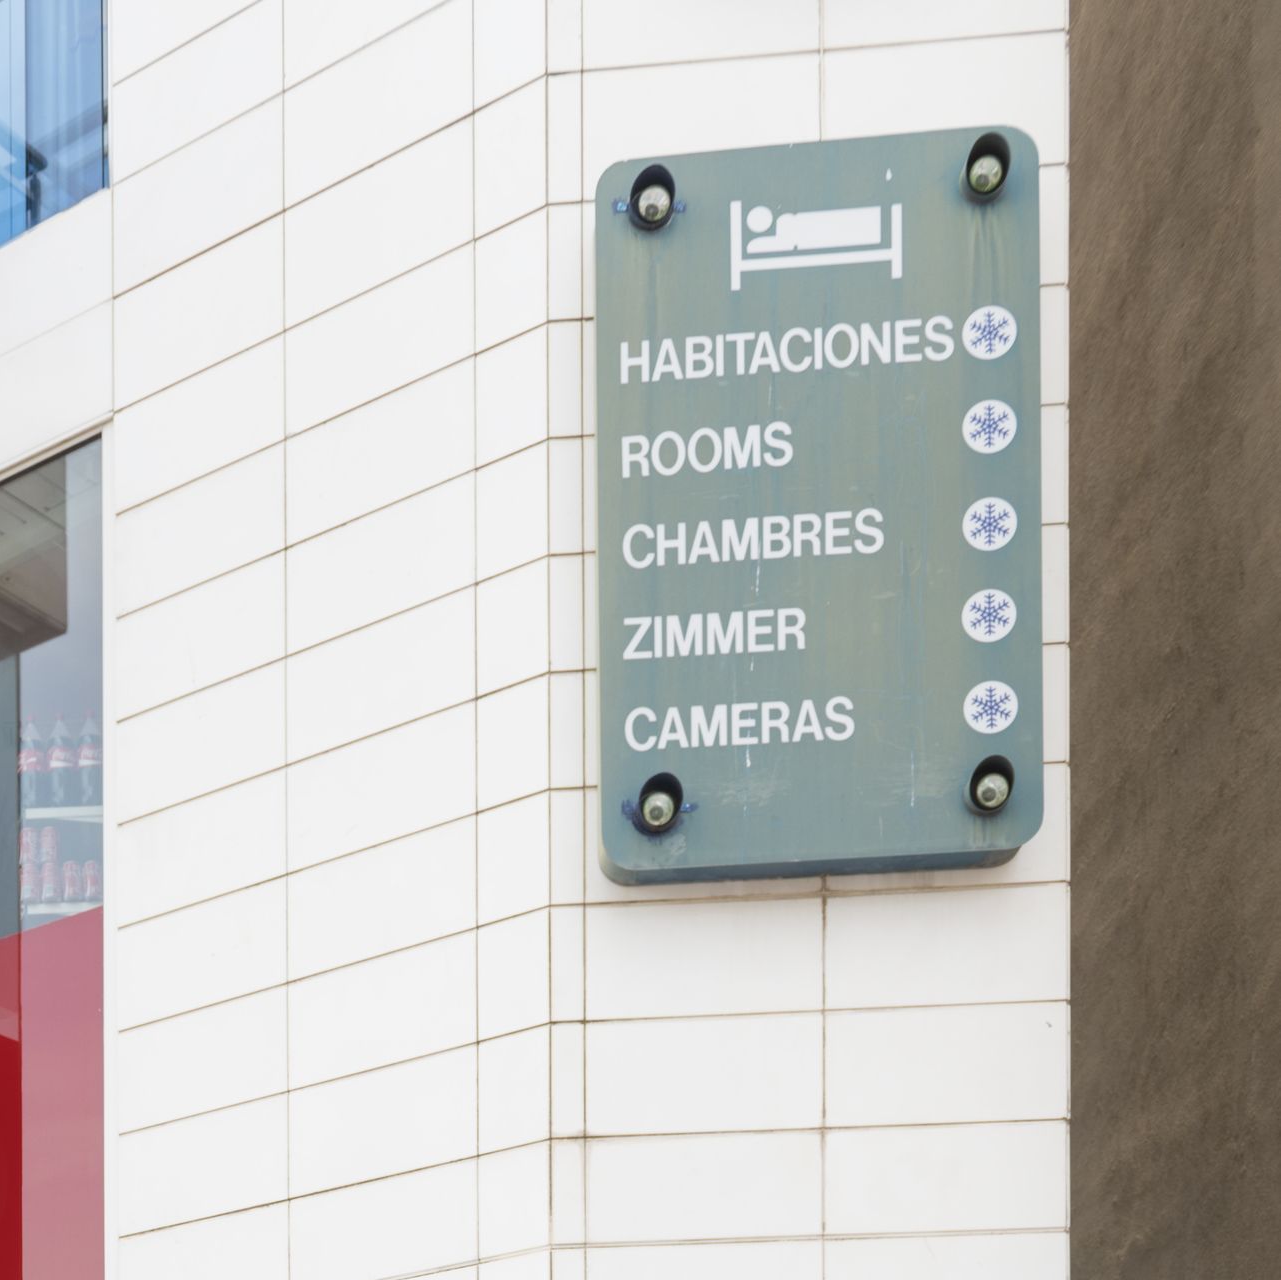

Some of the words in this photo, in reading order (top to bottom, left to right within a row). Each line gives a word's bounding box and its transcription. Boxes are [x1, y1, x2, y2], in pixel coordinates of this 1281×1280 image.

[619, 314, 955, 385] HABITACIONES
[621, 421, 794, 479] ROOMS
[621, 508, 886, 570] CHAMBRES
[622, 607, 807, 661] ZIMMER
[624, 696, 856, 752] CAMERAS
